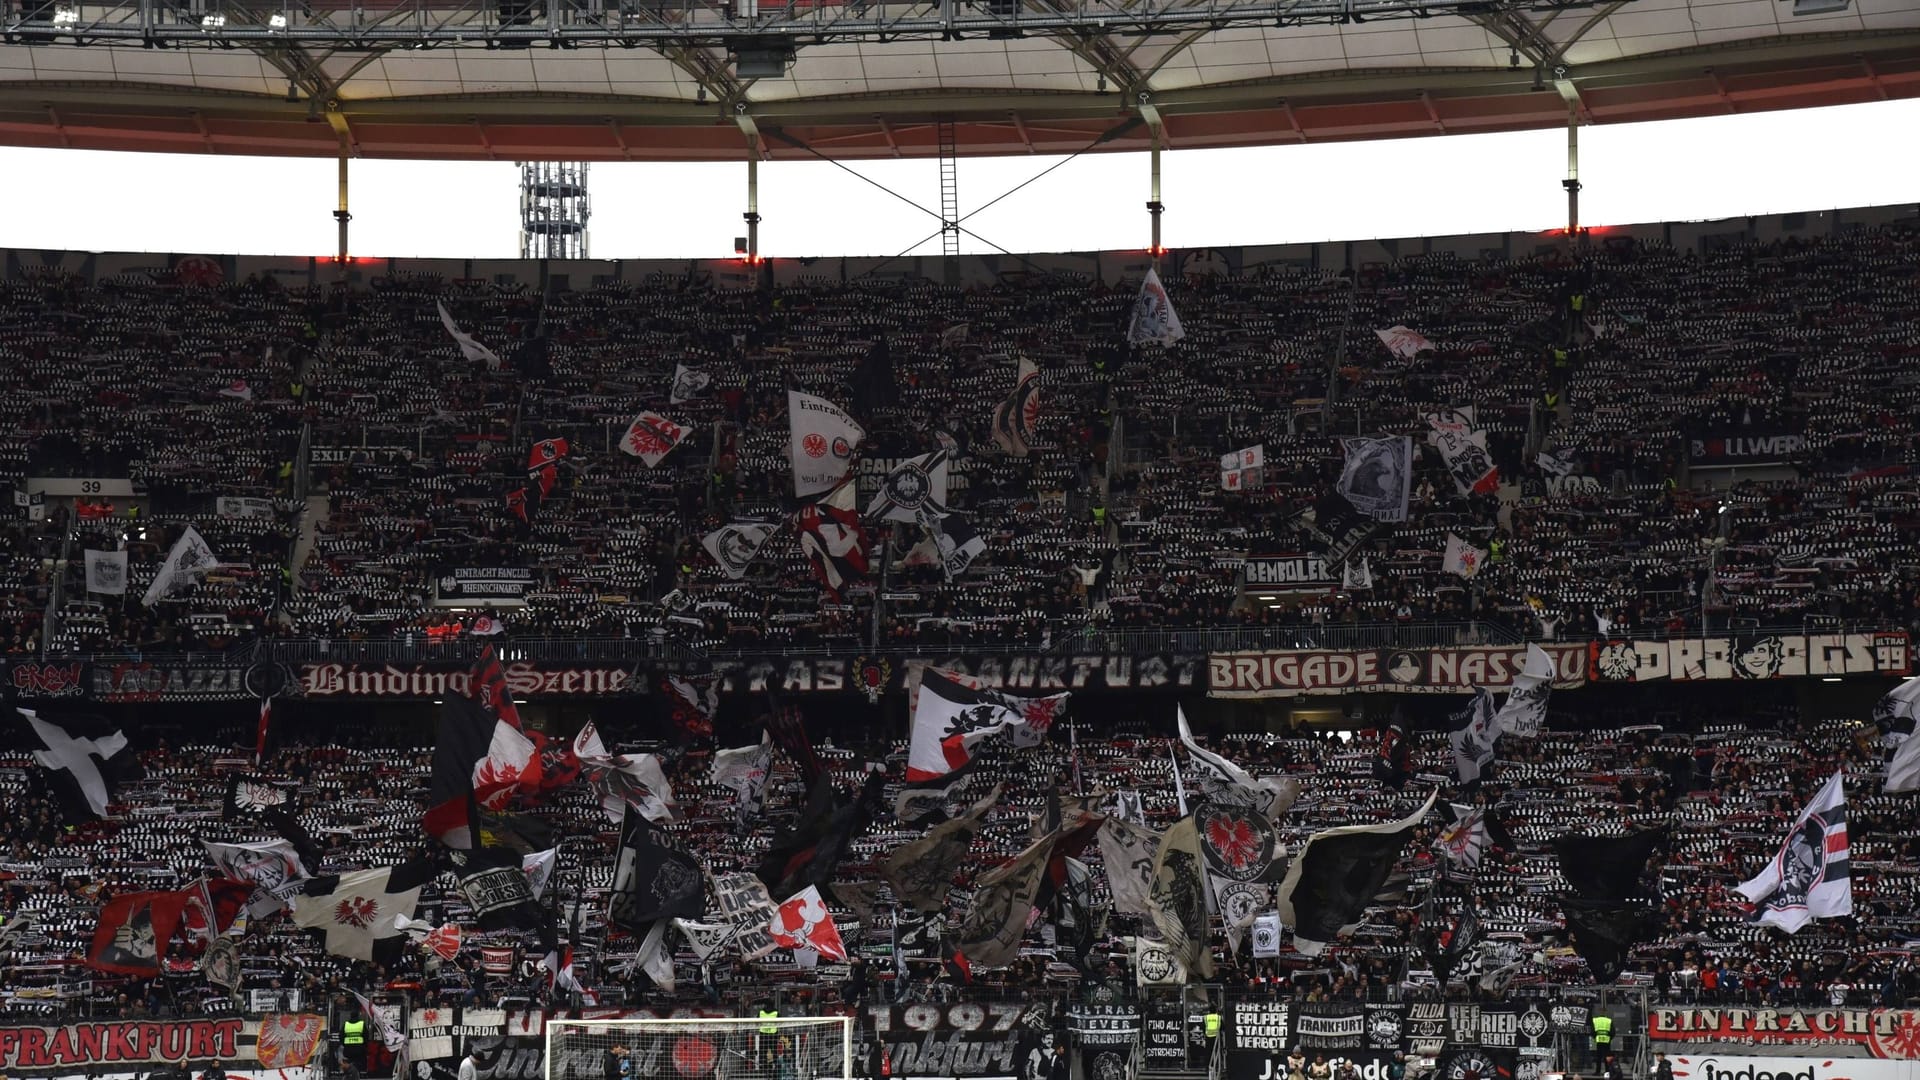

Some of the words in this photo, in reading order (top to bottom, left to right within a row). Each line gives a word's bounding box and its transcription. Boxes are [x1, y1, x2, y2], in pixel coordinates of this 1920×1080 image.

[82, 481, 101, 493] 39
[455, 568, 496, 578] EINTRACHT
[1876, 637, 1905, 650] ULTRAS
[1877, 646, 1904, 670] 99
[1210, 653, 1378, 691] BRIGADE
[1431, 648, 1585, 688] NASSU
[13, 663, 82, 691] CREW
[94, 669, 242, 692] RAGAZZI
[505, 662, 627, 695] Szene
[1340, 685, 1458, 695] HOOLIGANS
[868, 1003, 1026, 1031] 1997
[1072, 1005, 1135, 1015] ULTRAS
[1409, 1003, 1445, 1018] FULDA
[1077, 1019, 1130, 1030] NEVER
[1235, 1012, 1288, 1026] GRUPPE
[1301, 1018, 1362, 1033] FRANKFURT
[1481, 1014, 1517, 1033] RIED
[1656, 1009, 1898, 1035] EINTRACHT
[413, 1026, 446, 1039] NUOVA
[452, 1025, 498, 1036] GUARDIA
[1235, 1025, 1288, 1036] STADION
[1455, 1030, 1474, 1042] 64
[1236, 1037, 1288, 1049] VERBOT
[1481, 1034, 1517, 1046] GEBIET
[1687, 1034, 1713, 1043] auf
[1720, 1034, 1754, 1046] ewig
[1761, 1034, 1786, 1044] dir
[1791, 1035, 1856, 1048] ergeben
